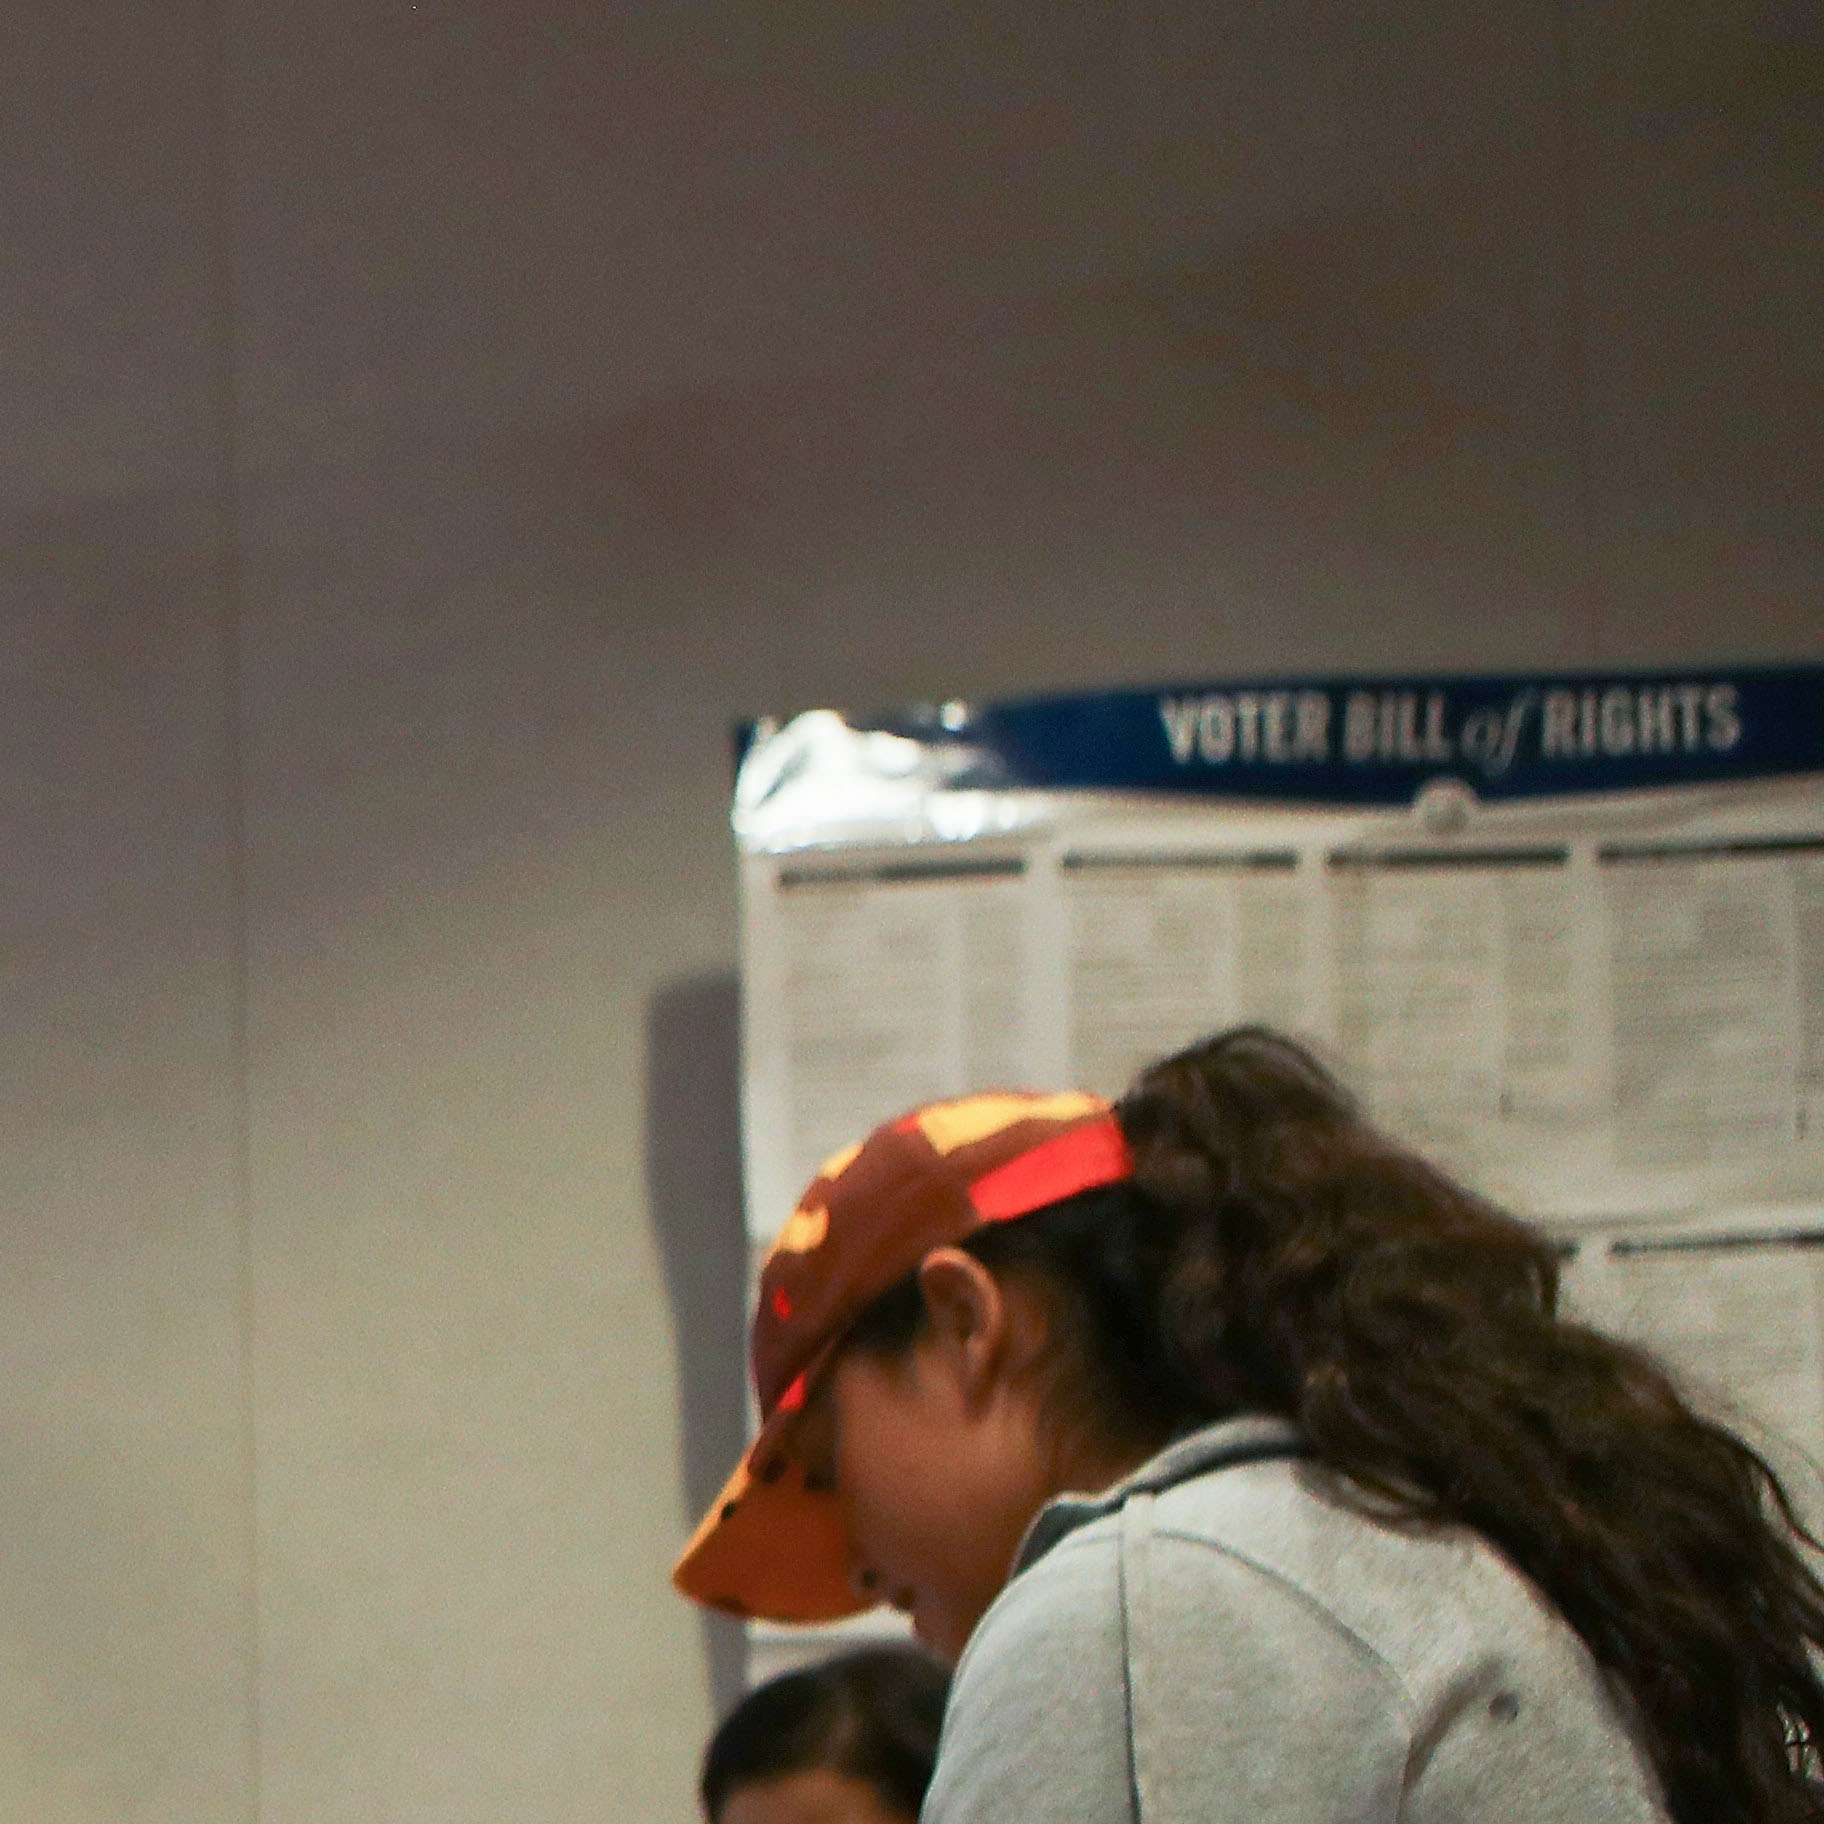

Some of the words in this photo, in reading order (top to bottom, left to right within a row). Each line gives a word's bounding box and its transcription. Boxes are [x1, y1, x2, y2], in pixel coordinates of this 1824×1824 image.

[1160, 688, 1330, 764] VOTER
[1344, 690, 1451, 763] BILL
[1460, 687, 1538, 778] of
[1542, 684, 1743, 757] RIGHTS
